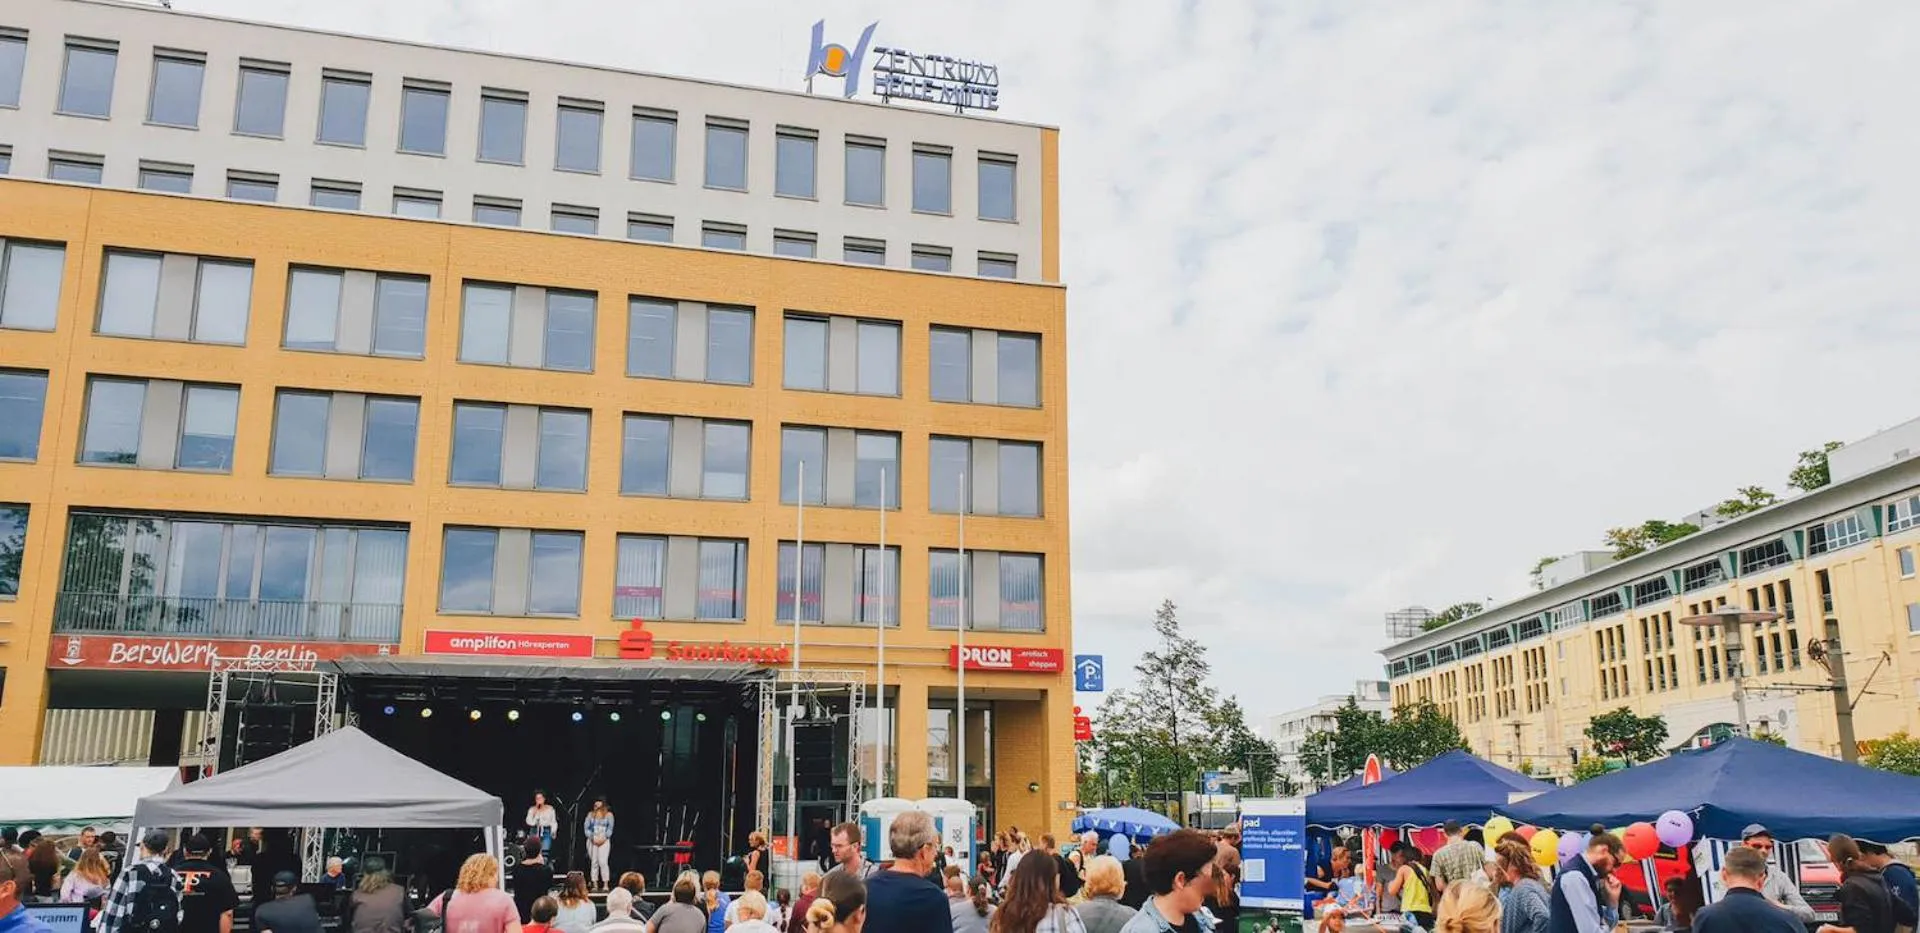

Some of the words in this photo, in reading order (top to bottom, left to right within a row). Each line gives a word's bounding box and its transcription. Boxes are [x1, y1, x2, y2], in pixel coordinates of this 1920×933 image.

[873, 46, 999, 87] ZENTRUM
[873, 73, 934, 101] HELLE
[940, 84, 999, 110] MITTE
[109, 641, 219, 665] BergWerk
[450, 635, 516, 651] amplifon
[518, 640, 569, 650] Hörexperten
[666, 639, 790, 662] Sparkasse
[963, 648, 1012, 667] ORION
[1085, 665, 1096, 679] P
[1243, 816, 1260, 829] pad
